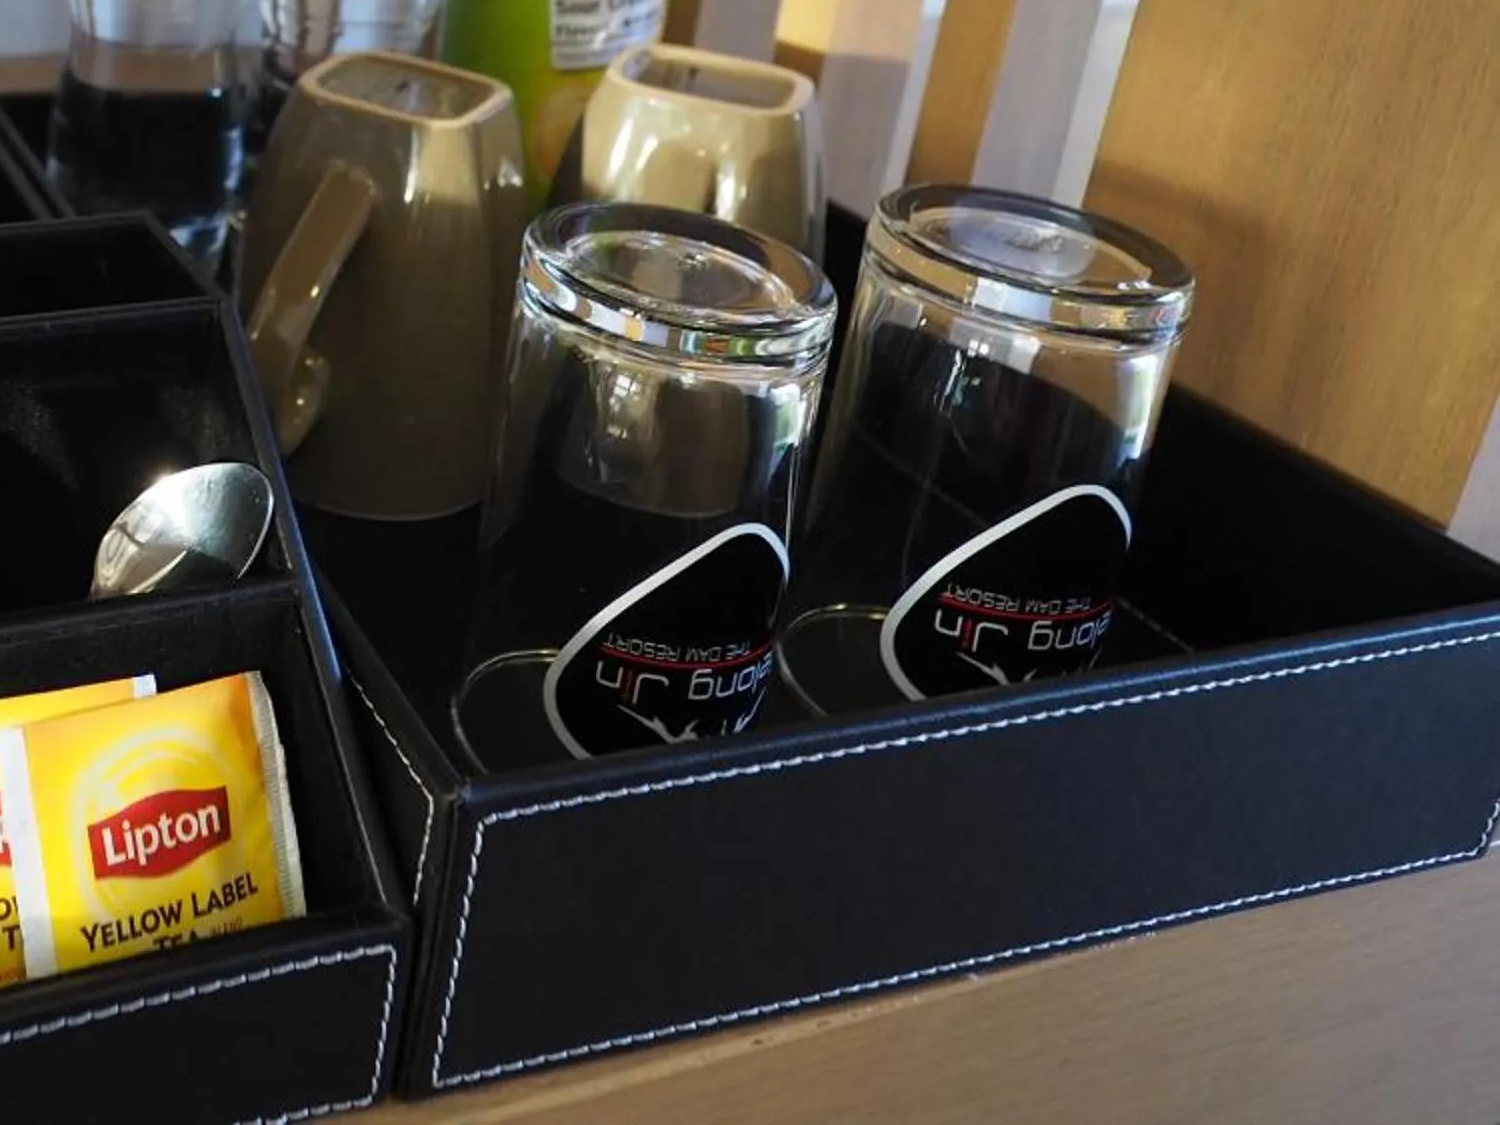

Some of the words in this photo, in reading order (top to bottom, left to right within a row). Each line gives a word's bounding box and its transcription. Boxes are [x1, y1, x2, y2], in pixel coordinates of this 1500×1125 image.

[933, 607, 1010, 653] Jin
[595, 659, 670, 705] Jin
[101, 803, 220, 867] Lipton
[80, 900, 183, 953] YELLOW
[190, 871, 259, 919] LABEL
